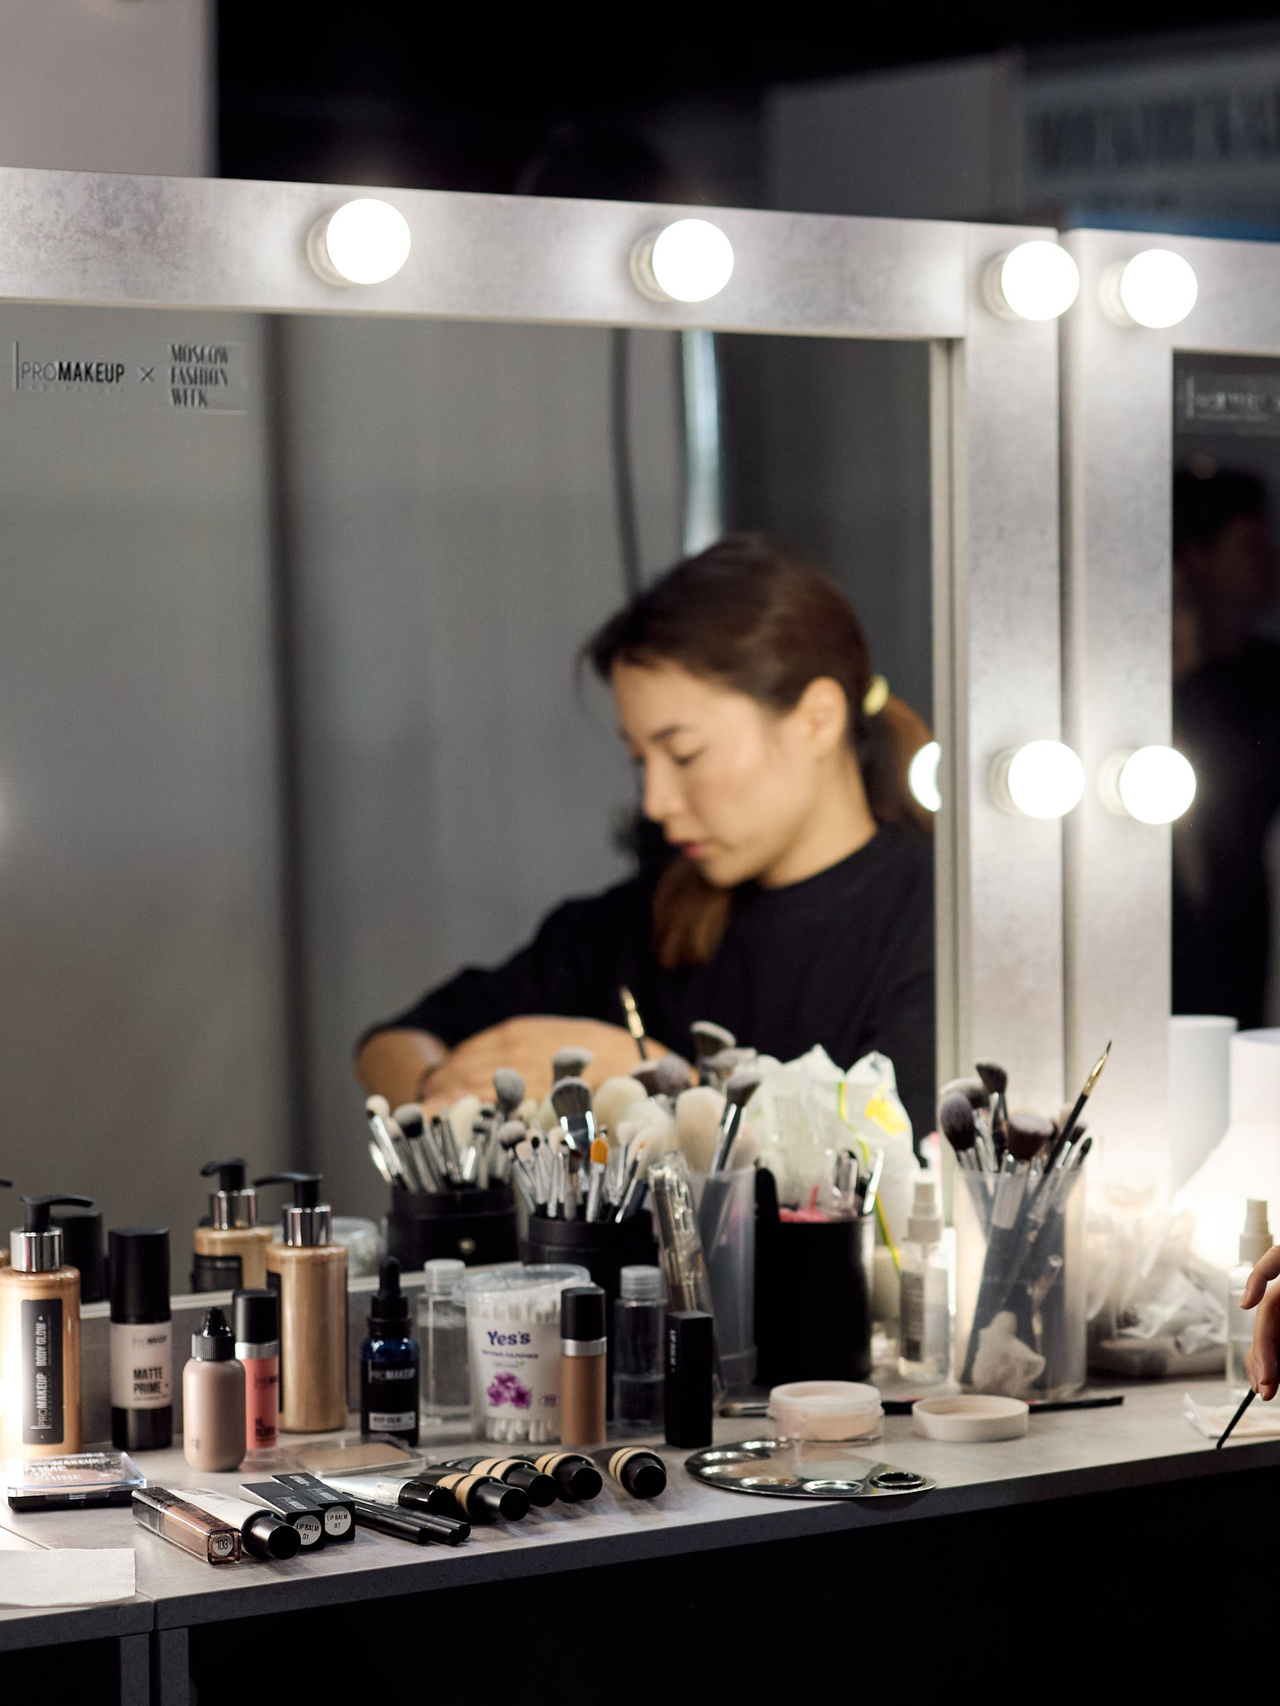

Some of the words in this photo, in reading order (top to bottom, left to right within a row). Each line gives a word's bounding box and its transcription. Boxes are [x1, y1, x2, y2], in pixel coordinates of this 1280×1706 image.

[170, 343, 229, 364] MOSCOW
[20, 361, 125, 383] PROMAKEUP
[170, 366, 229, 387] FASHION
[171, 388, 208, 408] WEEK
[35, 1322, 47, 1345] GLOW
[487, 1330, 531, 1346] Yes's
[35, 1345, 47, 1367] BODY
[133, 1367, 163, 1380] MATTE
[133, 1381, 161, 1394] PRIME
[216, 1539, 229, 1550] 103
